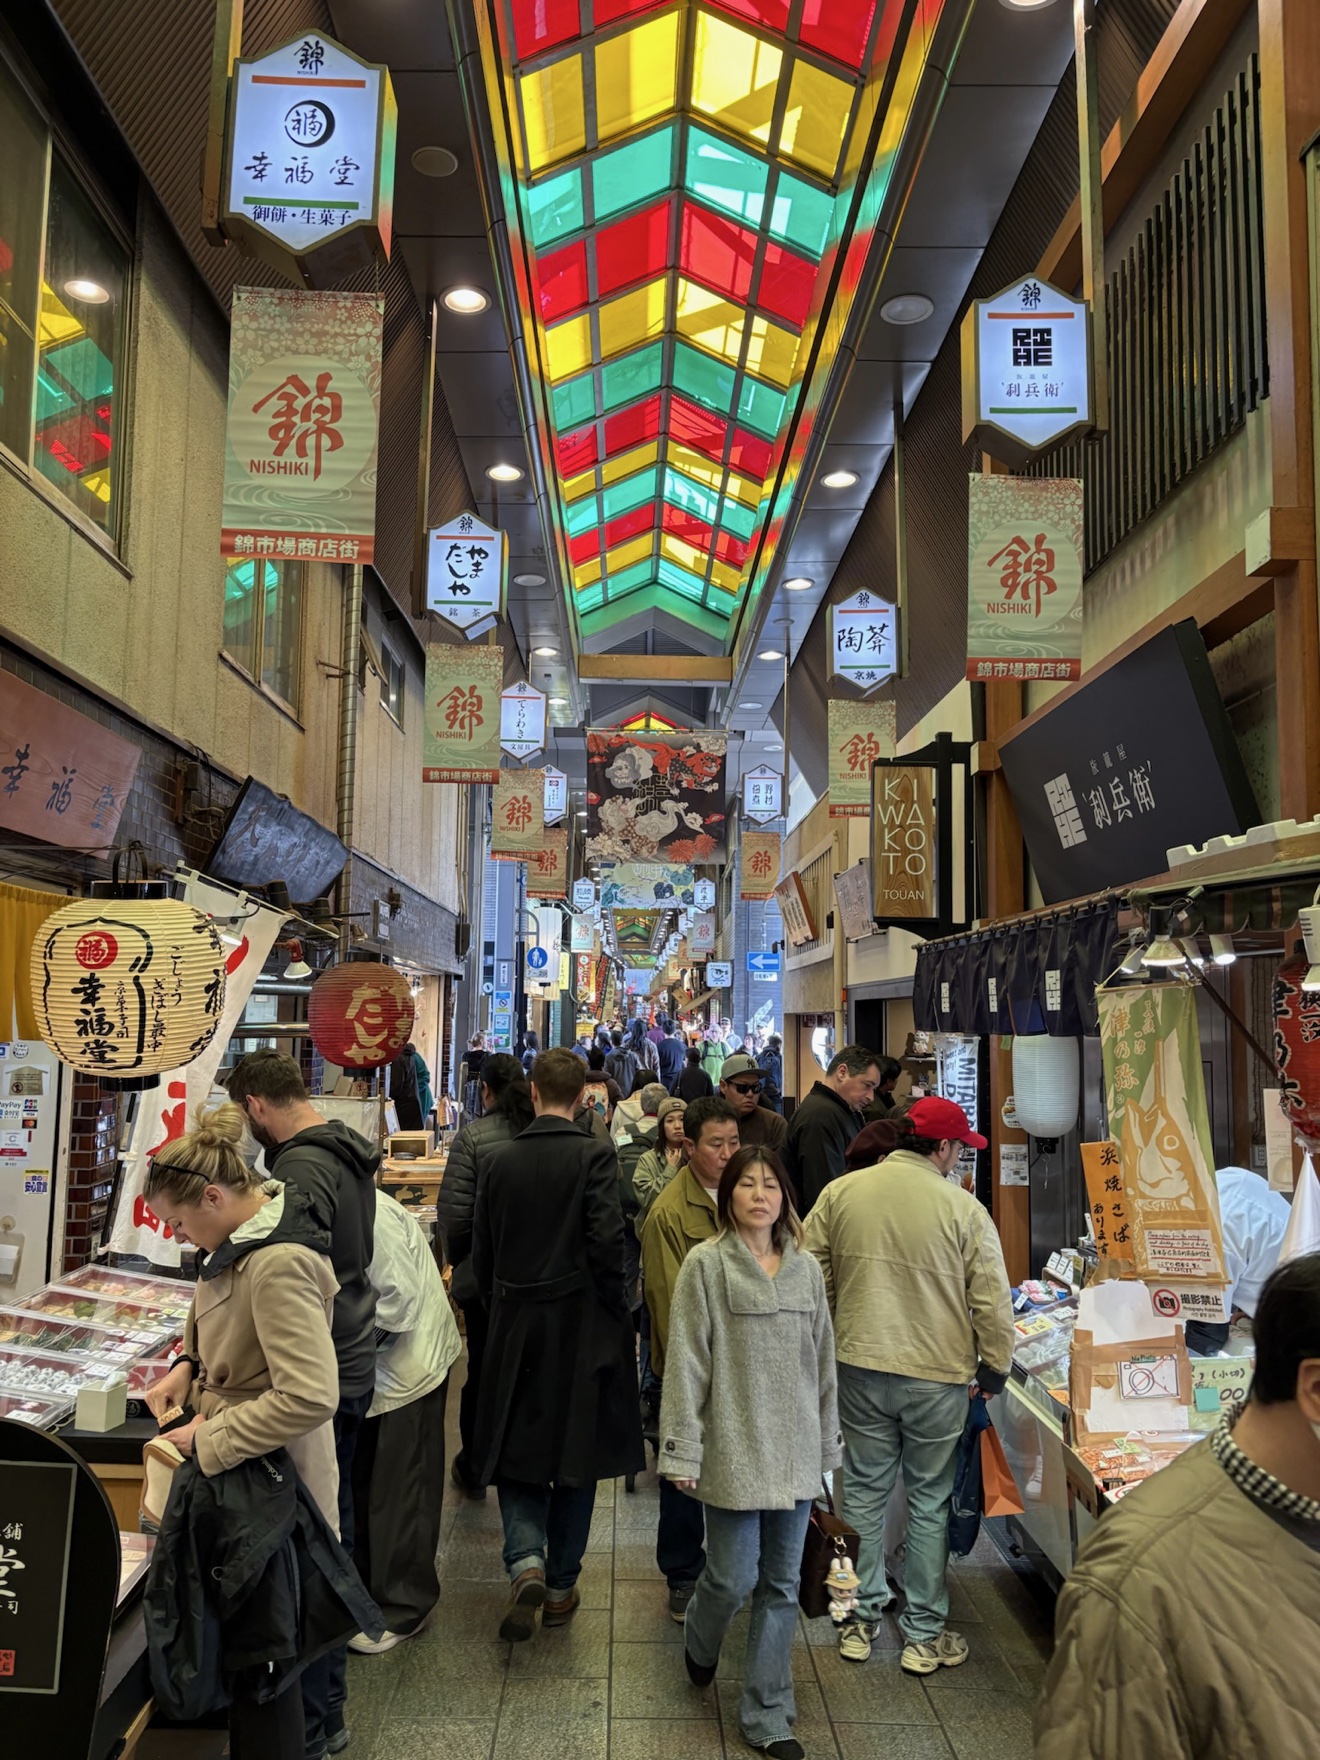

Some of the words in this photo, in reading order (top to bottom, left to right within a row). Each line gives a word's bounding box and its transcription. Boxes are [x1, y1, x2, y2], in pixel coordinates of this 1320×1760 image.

[294, 40, 325, 75] 錦
[291, 109, 323, 137] 福
[244, 152, 360, 186] 幸福堂
[1017, 282, 1041, 310] 錦
[252, 372, 344, 481] 錦
[250, 459, 309, 475] NISHIKI
[457, 516, 473, 534] 錦
[234, 534, 359, 559] 錦市場商店街
[466, 545, 489, 578] やま
[445, 543, 471, 596] だしや
[987, 532, 1057, 619] 錦
[856, 592, 870, 607] 錦
[986, 602, 1031, 614] NISHIKI
[977, 662, 1071, 678] 錦市場商店街
[437, 685, 484, 742] 錦
[516, 699, 526, 739] てらわき
[436, 731, 466, 739] NISHIKI
[840, 732, 880, 781] 錦
[429, 770, 492, 782] 錦市場商店街
[840, 772, 866, 780] NISHIKI
[501, 795, 533, 833] 錦
[748, 850, 772, 879] 錦
[883, 889, 925, 900] TOUAN
[170, 946, 186, 1006] ごじょう
[71, 973, 119, 1063] 幸福堂
[147, 978, 167, 1052] ぎぼし最中
[344, 982, 389, 1064] だしや
[1100, 1146, 1130, 1243] 浜焼さば
[1094, 1203, 1109, 1258] あります
[1180, 1293, 1222, 1306] 撮影禁止
[0, 1523, 23, 1541] 舗
[0, 1601, 19, 1615] 司
